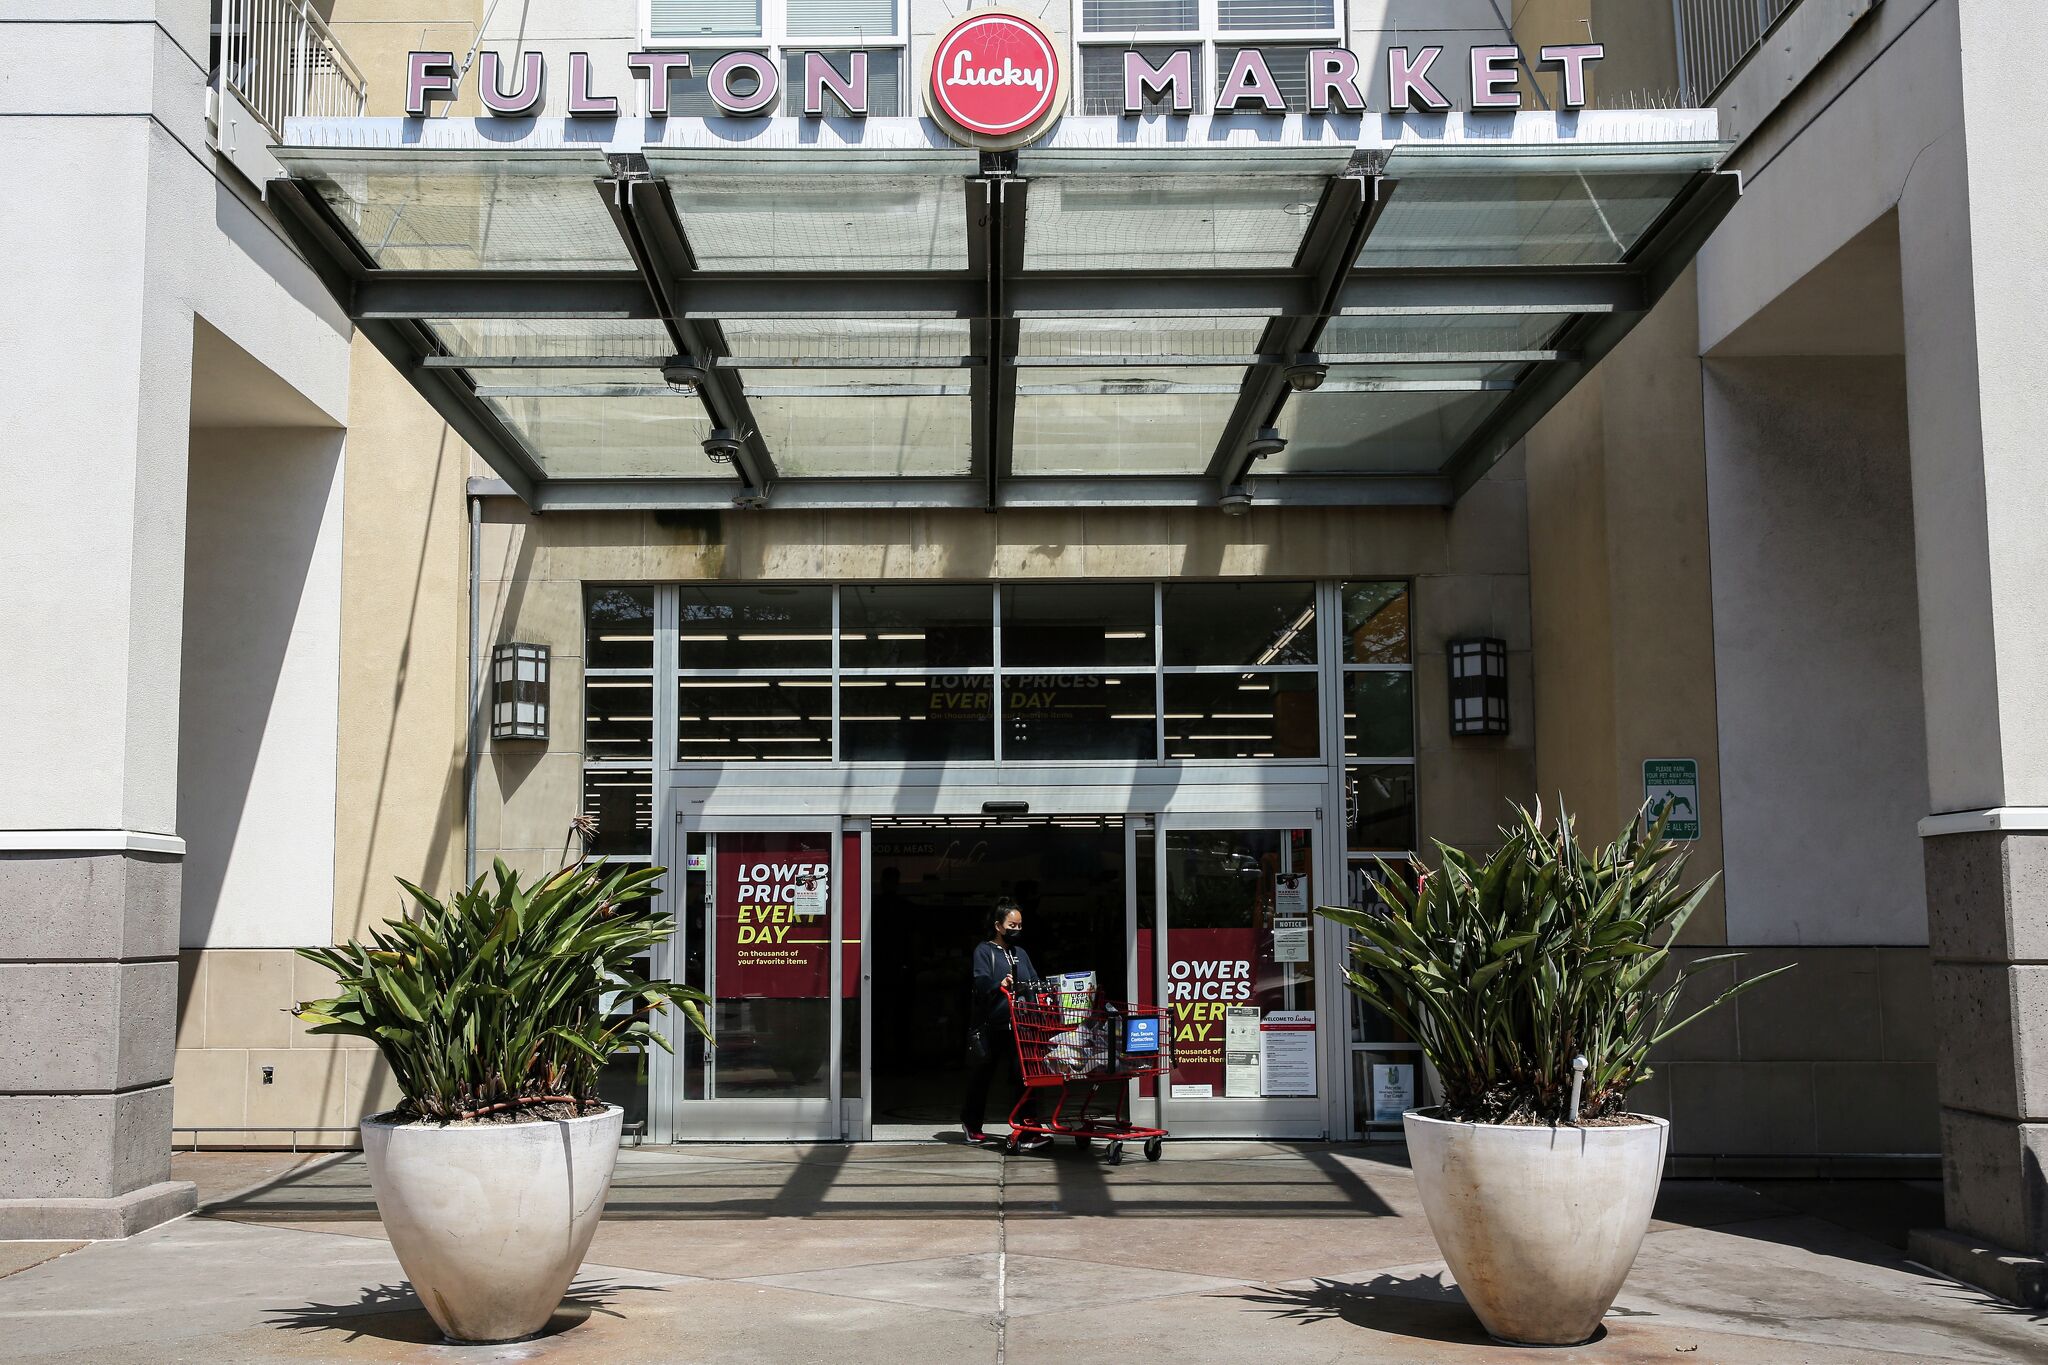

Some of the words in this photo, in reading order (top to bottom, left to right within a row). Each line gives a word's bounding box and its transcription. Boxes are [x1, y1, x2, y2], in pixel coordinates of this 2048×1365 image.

[944, 49, 1043, 93] Lucky
[404, 50, 868, 118] FULTON
[1122, 44, 1604, 116] MARKET
[1019, 675, 1100, 688] PRICES
[929, 692, 989, 709] EVER
[1010, 692, 1056, 709] DAY
[1673, 823, 1682, 831] ALL
[738, 864, 829, 882] LOWER
[738, 885, 829, 903] PRIC
[738, 926, 790, 944] DAY
[1168, 961, 1250, 979] OWER
[1168, 1002, 1243, 1020] VER
[1294, 1014, 1312, 1022] Lucky
[1174, 1023, 1212, 1042] AY
